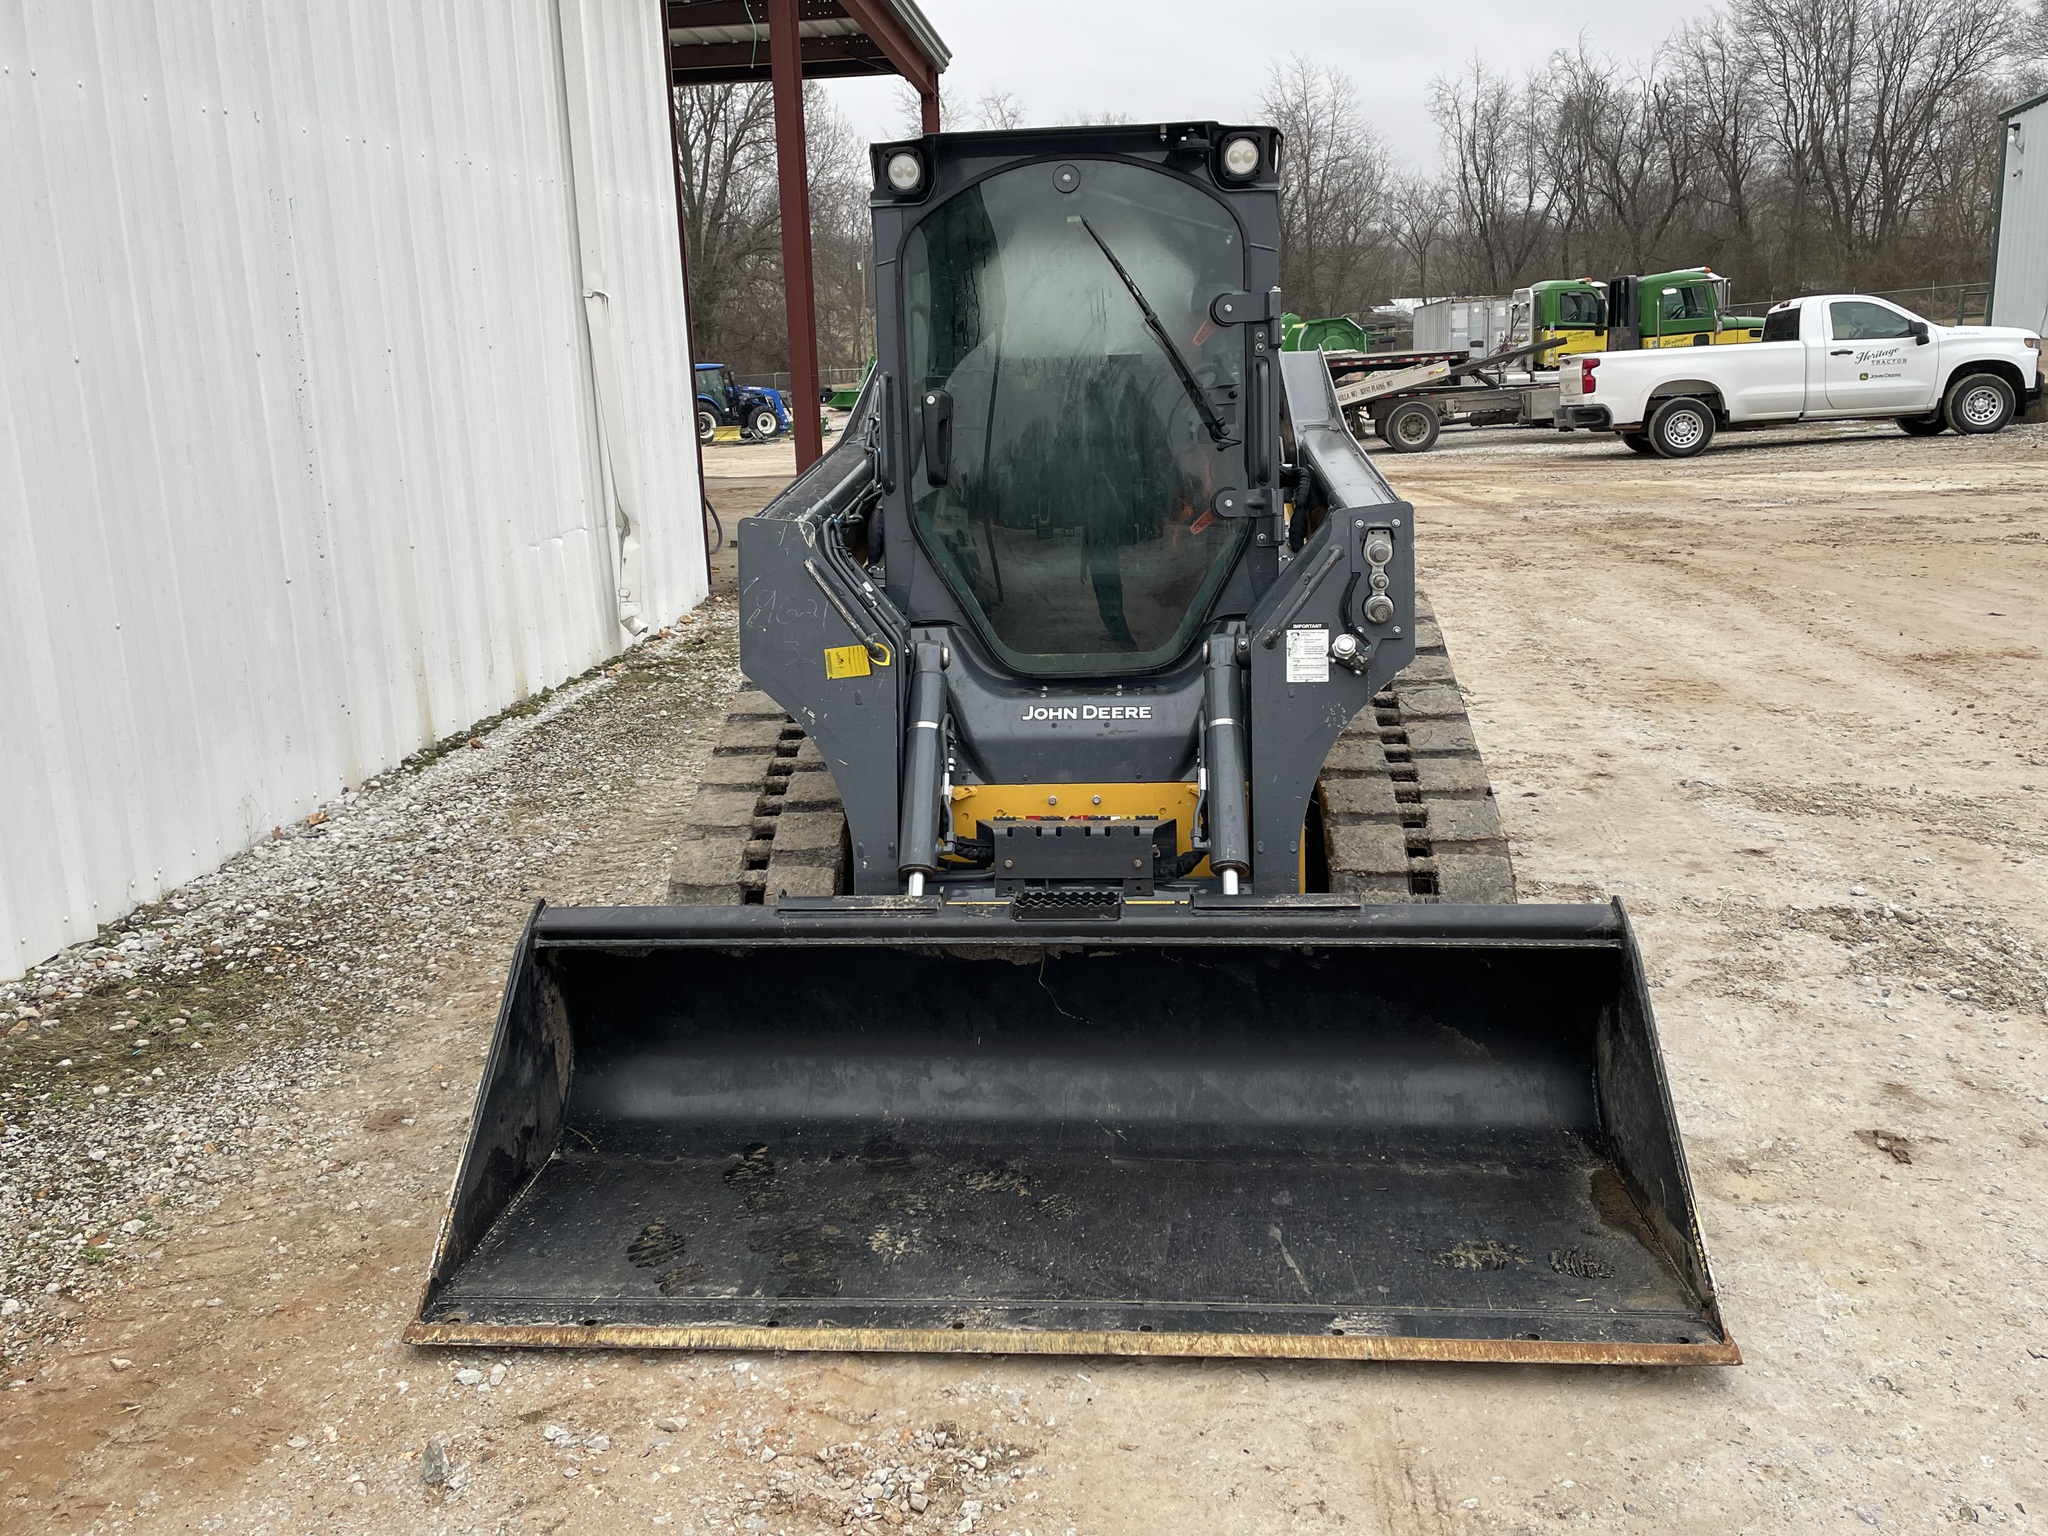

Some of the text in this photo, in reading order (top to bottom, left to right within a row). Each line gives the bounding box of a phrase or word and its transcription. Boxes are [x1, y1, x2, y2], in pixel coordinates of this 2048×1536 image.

[1855, 347, 1900, 365] Heritage
[1871, 358, 1908, 366] TRACTOR
[1360, 387, 1371, 395] WEST
[1371, 383, 1386, 392] PLAINS
[1022, 704, 1153, 720] JOHN DEERE
